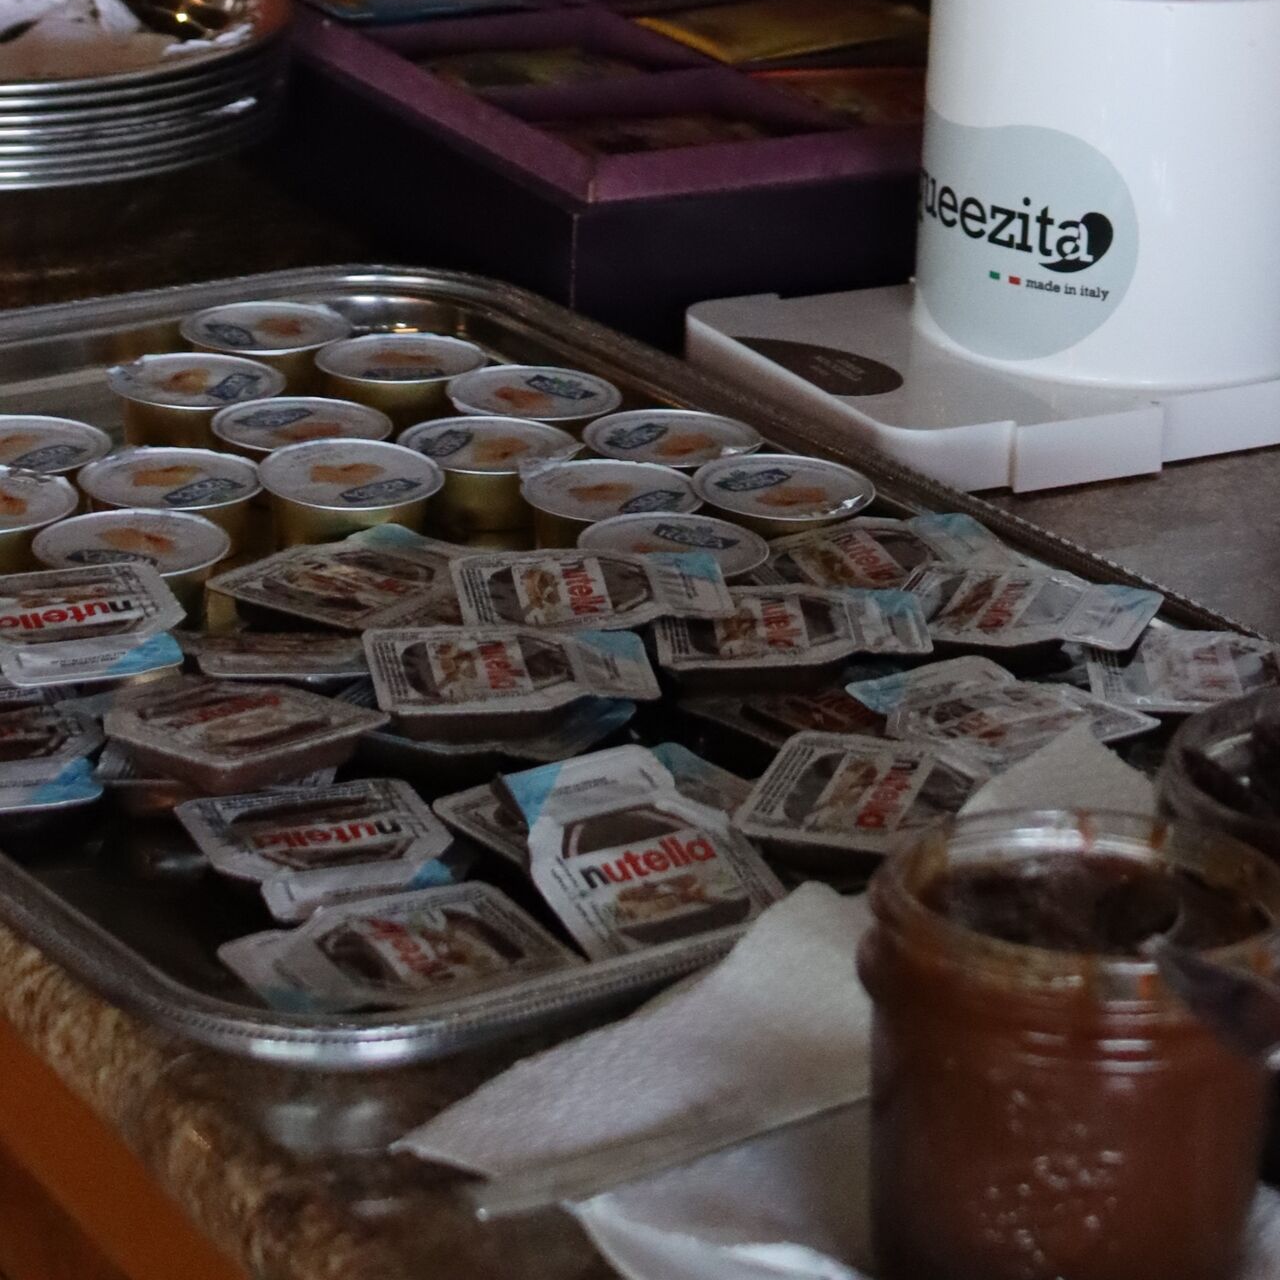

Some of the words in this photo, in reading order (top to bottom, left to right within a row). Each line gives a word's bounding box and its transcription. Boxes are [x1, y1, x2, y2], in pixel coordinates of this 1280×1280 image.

[920, 169, 1113, 273] ueezita
[1026, 278, 1060, 293] made
[1064, 283, 1077, 295] in
[1079, 286, 1109, 301] italy
[579, 836, 717, 890] nutella
